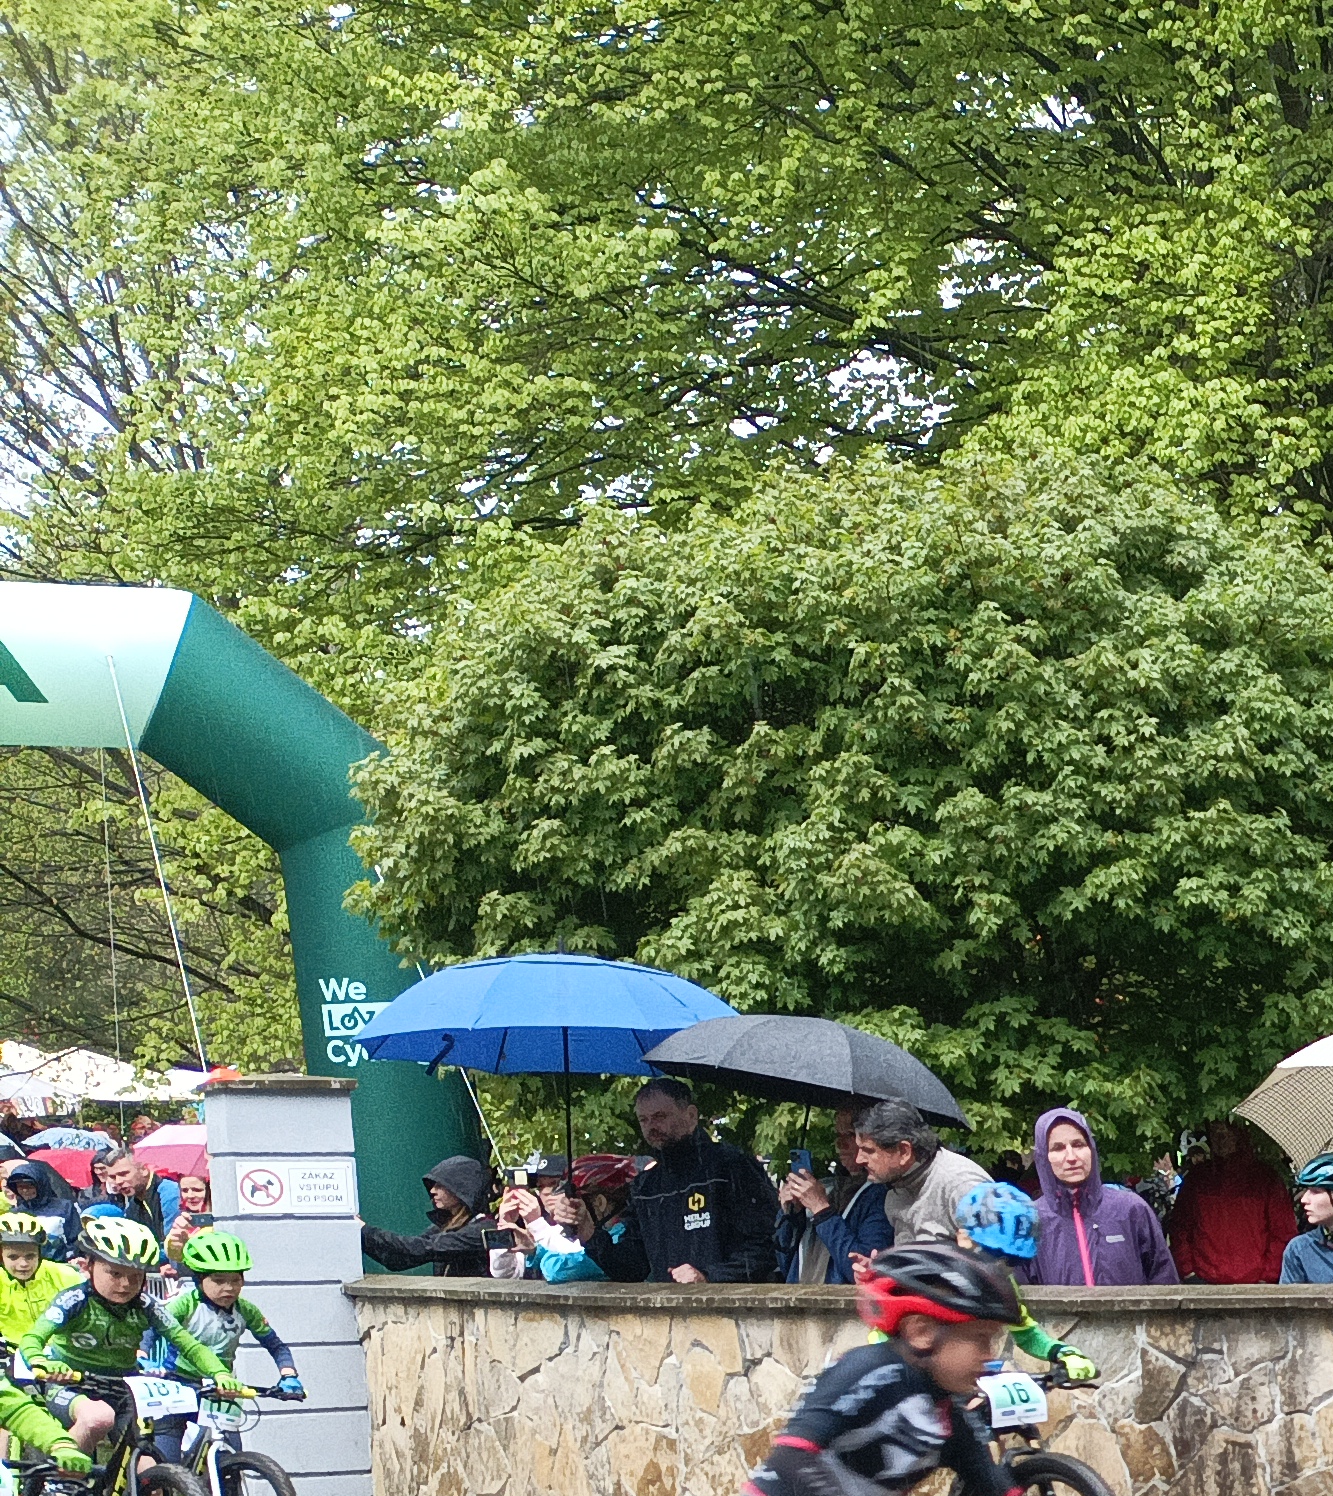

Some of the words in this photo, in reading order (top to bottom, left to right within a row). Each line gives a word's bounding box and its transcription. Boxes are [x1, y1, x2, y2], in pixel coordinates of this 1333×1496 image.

[318, 977, 367, 1002] We
[298, 1183, 339, 1191] VSTUPU
[296, 1195, 311, 1203] SO
[314, 1194, 343, 1203] PSOM
[1002, 1382, 1031, 1406] 16
